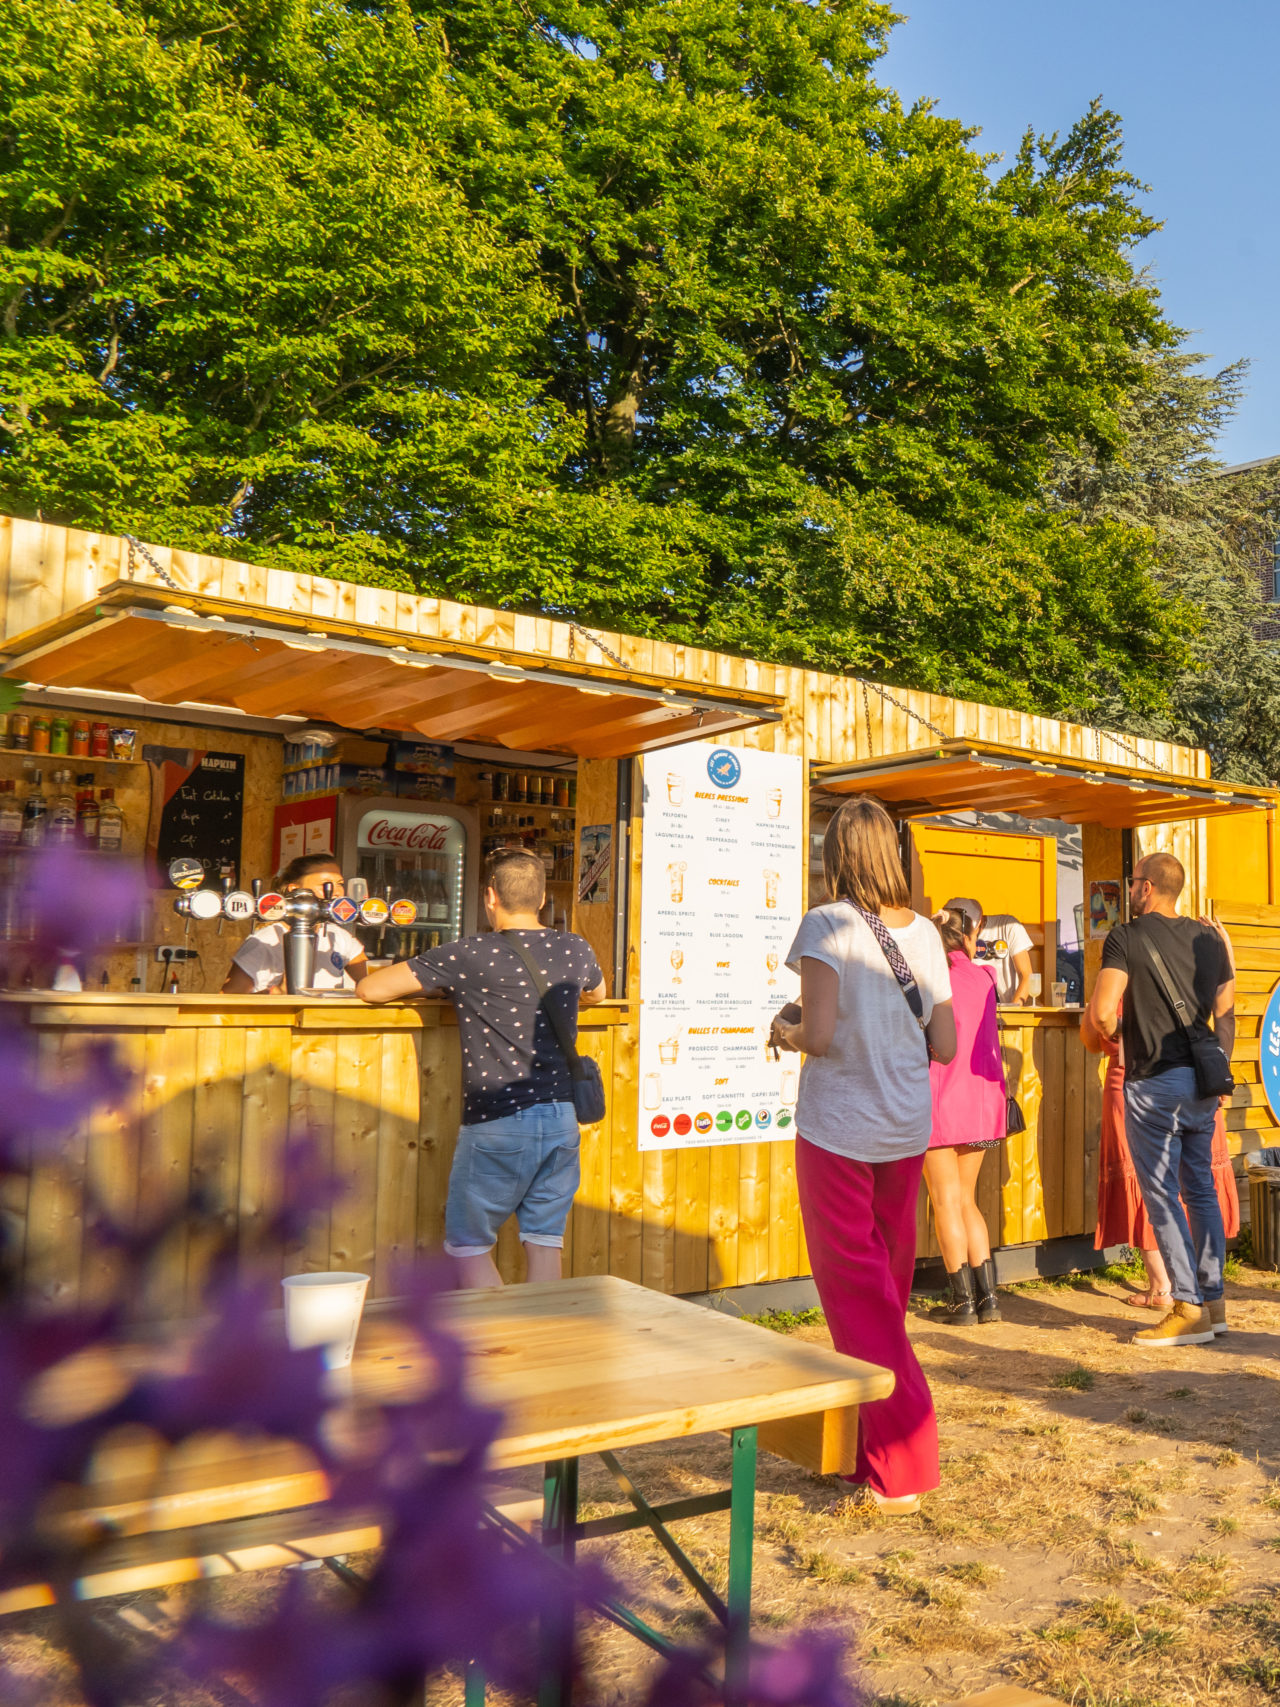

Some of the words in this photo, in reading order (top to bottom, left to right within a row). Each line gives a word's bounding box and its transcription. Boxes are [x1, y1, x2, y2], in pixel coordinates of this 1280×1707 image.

[201, 757, 237, 769] HAPKIN
[716, 793, 749, 804] PRESSIONS
[662, 811, 688, 819] PELFORTH
[368, 819, 452, 850] Coca-Cola
[708, 878, 740, 887] COCKTAILS
[231, 901, 248, 913] IPA
[716, 961, 731, 969] VINS
[688, 1026, 711, 1036] BULLES
[711, 1026, 719, 1036] ET
[720, 1026, 755, 1036] CHAMPAGNE
[714, 1077, 729, 1086] SOFT
[702, 1093, 716, 1101] SOFT
[717, 1092, 745, 1100] CANNETTE
[751, 1091, 768, 1099] CAPRI
[768, 1090, 780, 1098] SUN
